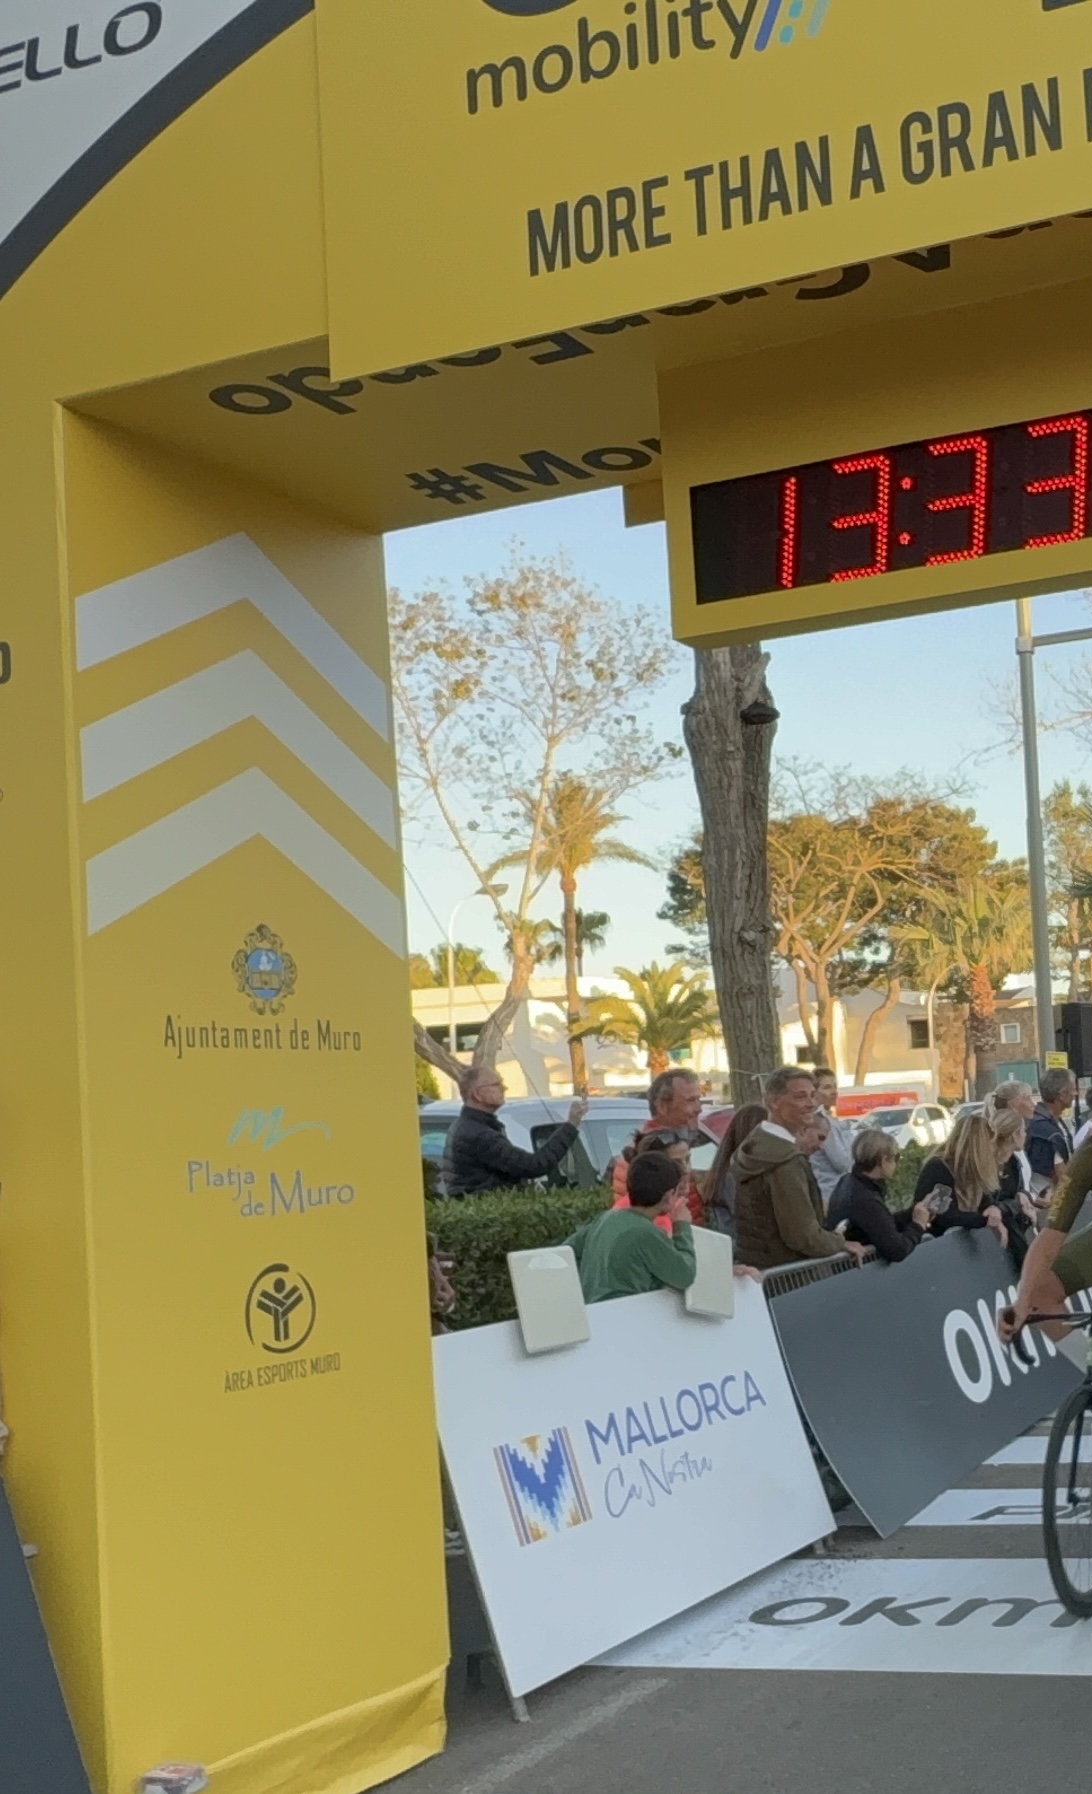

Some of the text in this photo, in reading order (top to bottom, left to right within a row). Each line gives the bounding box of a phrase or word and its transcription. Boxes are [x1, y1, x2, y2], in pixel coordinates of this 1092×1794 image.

[466, 0, 757, 115] mobility
[526, 176, 671, 277] MORE
[684, 134, 832, 238] THAN
[848, 123, 886, 200] A
[899, 76, 1064, 186] GRAN
[164, 1014, 362, 1059] Ajuntament de Muro
[187, 1160, 256, 1202] Platja
[240, 1169, 356, 1217] de Muro
[223, 1352, 341, 1393] ÀREA ESPORTS MURO
[584, 1370, 767, 1465] MALLORCA
